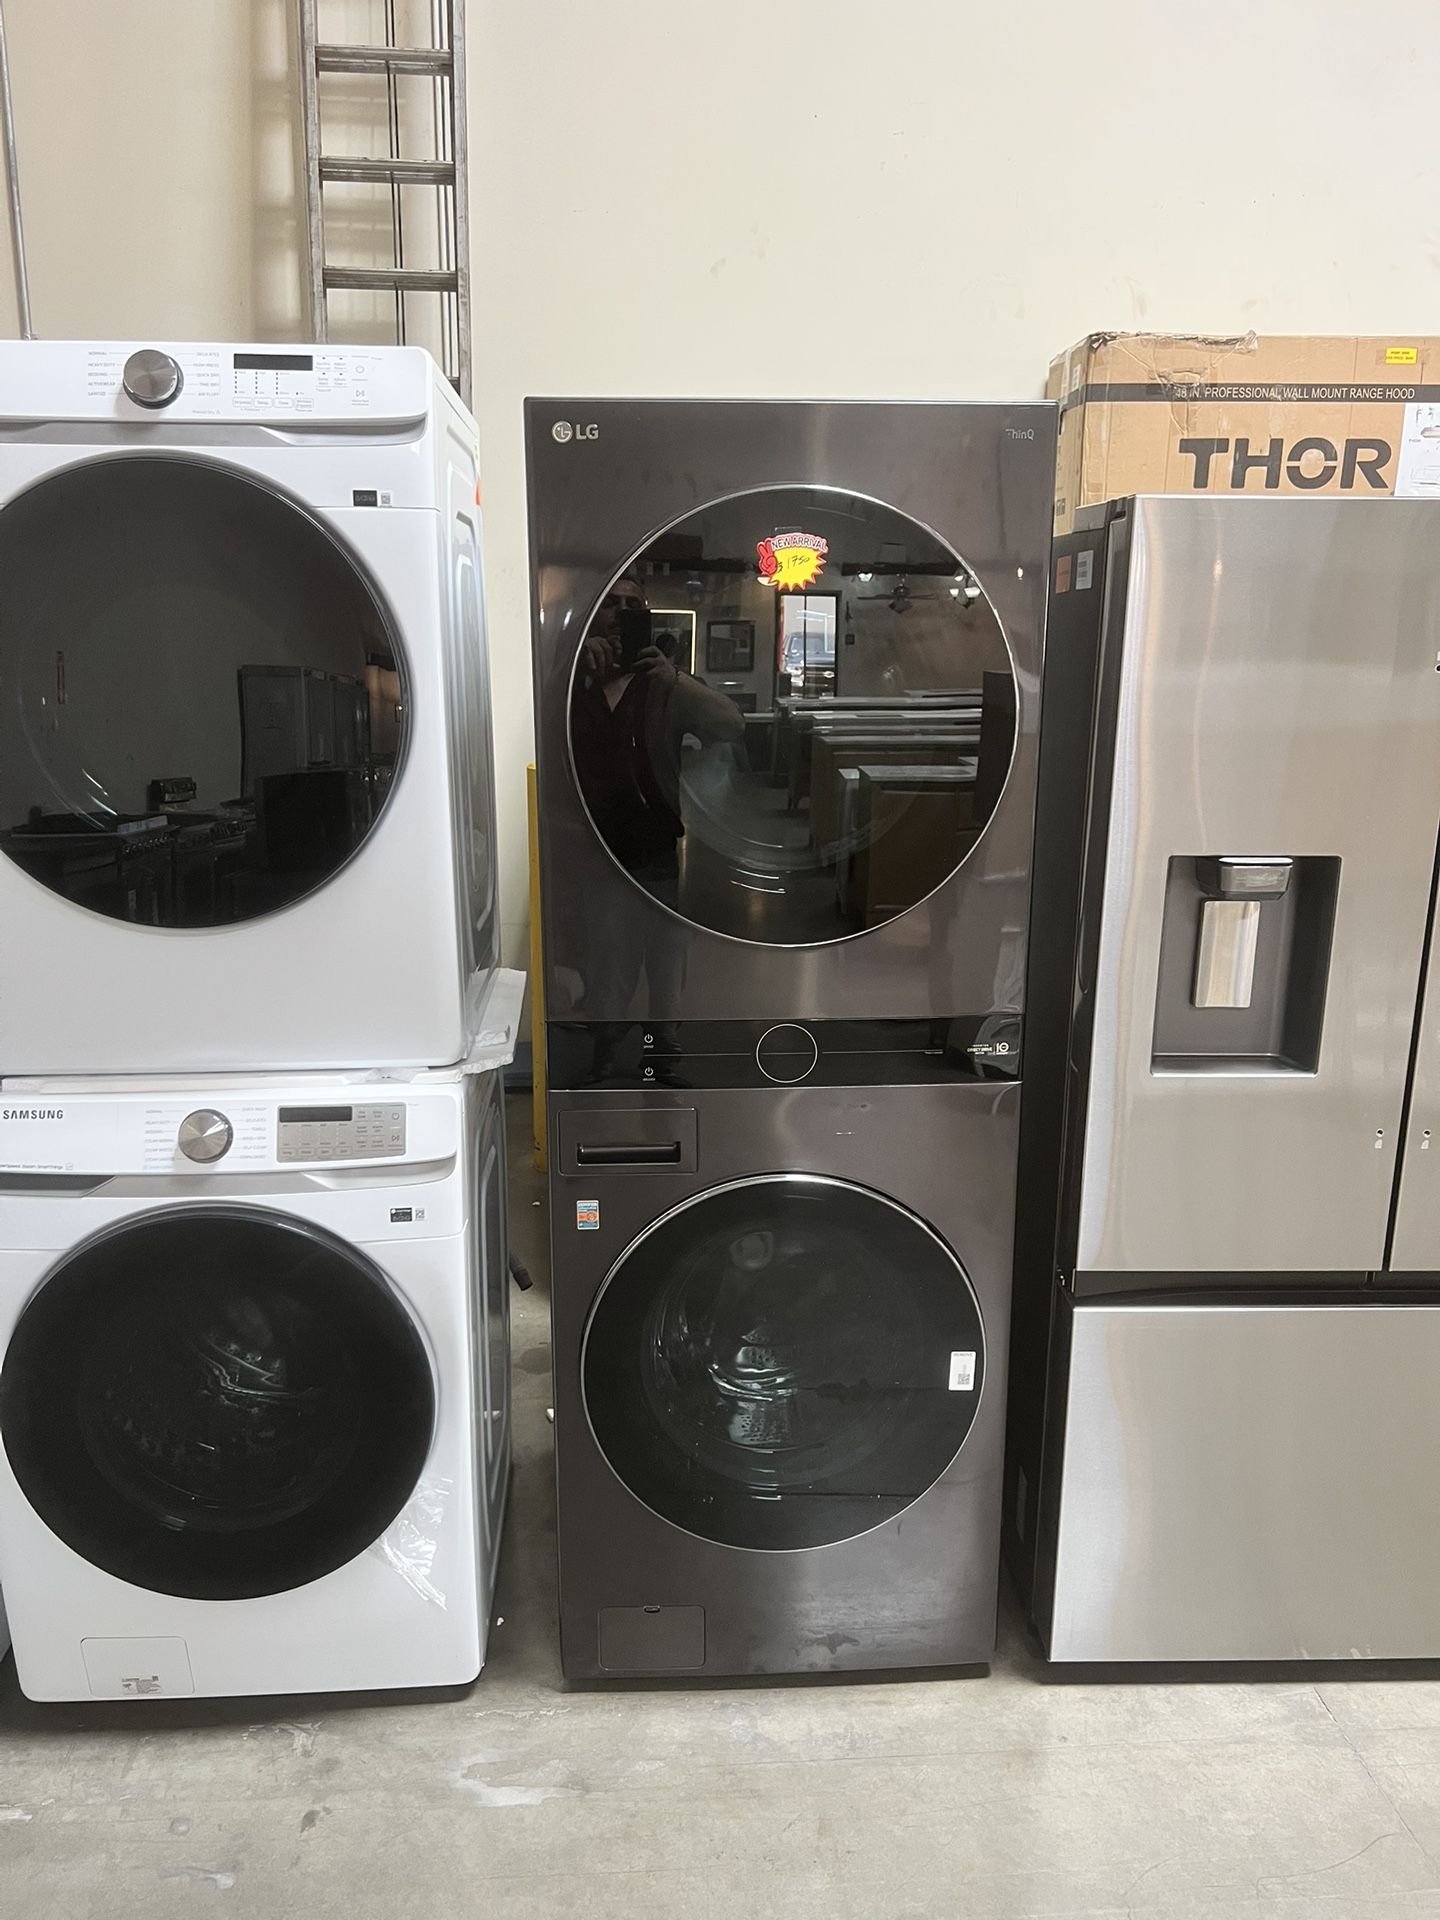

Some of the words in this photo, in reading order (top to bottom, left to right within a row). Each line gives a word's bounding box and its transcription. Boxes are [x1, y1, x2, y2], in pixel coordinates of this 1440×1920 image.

[1204, 387, 1280, 398] PROFESSIONAL
[1283, 387, 1309, 399] WALL
[1311, 387, 1348, 399] MOUNT
[1349, 387, 1383, 399] RANGE
[1386, 387, 1415, 399] HOOD
[576, 423, 599, 440] LG
[1004, 428, 1034, 441] ThinQ
[1179, 437, 1392, 489] THOR
[772, 537, 790, 549] NEW
[792, 536, 826, 550] ARRIVAL
[3, 1109, 64, 1120] SAMSUNG
